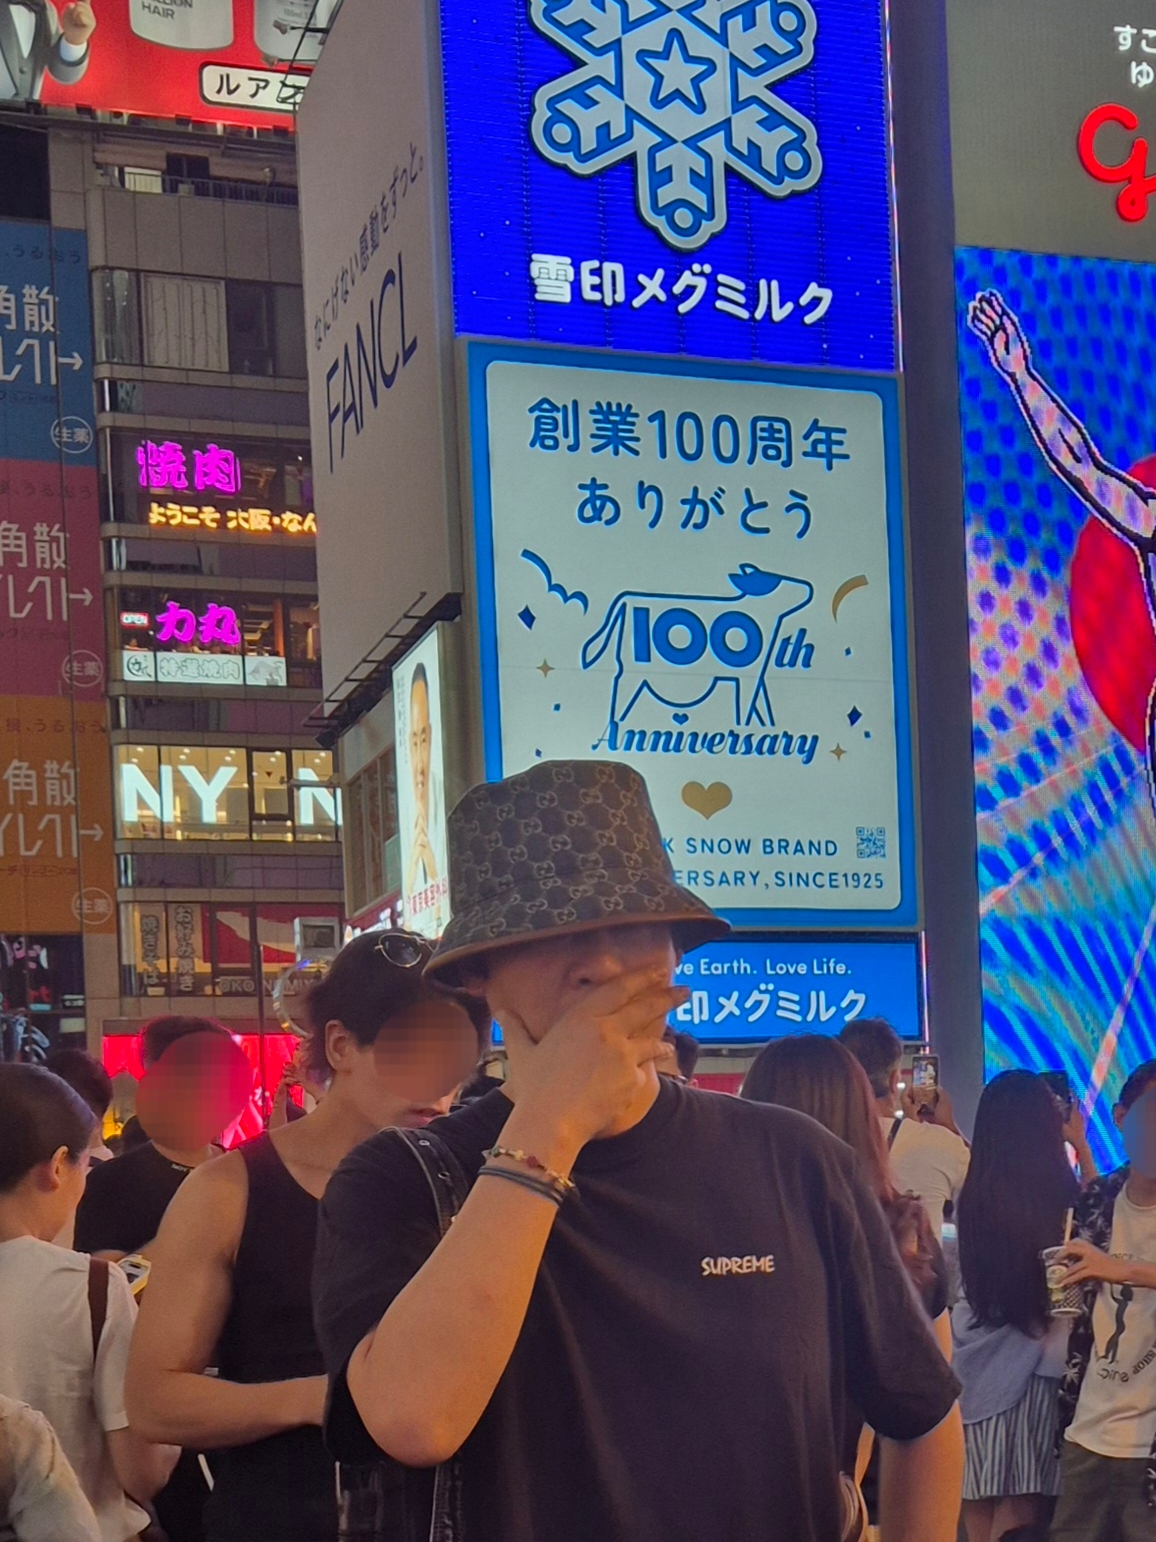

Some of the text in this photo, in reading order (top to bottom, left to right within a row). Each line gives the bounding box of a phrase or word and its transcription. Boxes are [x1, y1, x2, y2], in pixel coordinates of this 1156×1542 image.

[142, 1, 175, 20] HAIR
[530, 253, 833, 325] 雪印メグミルク
[327, 252, 417, 474] FANCL
[528, 397, 850, 471] 創業100周年
[137, 441, 241, 493] 焼肉
[150, 502, 220, 529] ようこそ
[577, 477, 812, 538] ありがとう
[157, 601, 241, 646] 力丸
[591, 719, 819, 764] Anniversary
[3, 759, 78, 806] 角散
[121, 763, 238, 823] NY
[686, 837, 751, 855] SNOW
[762, 838, 838, 856] BRAND
[174, 905, 195, 991] お好み焼き
[701, 958, 757, 975] Earth.
[766, 959, 807, 974] Love
[813, 958, 852, 974] Life.
[701, 1254, 775, 1276] SUPREME
